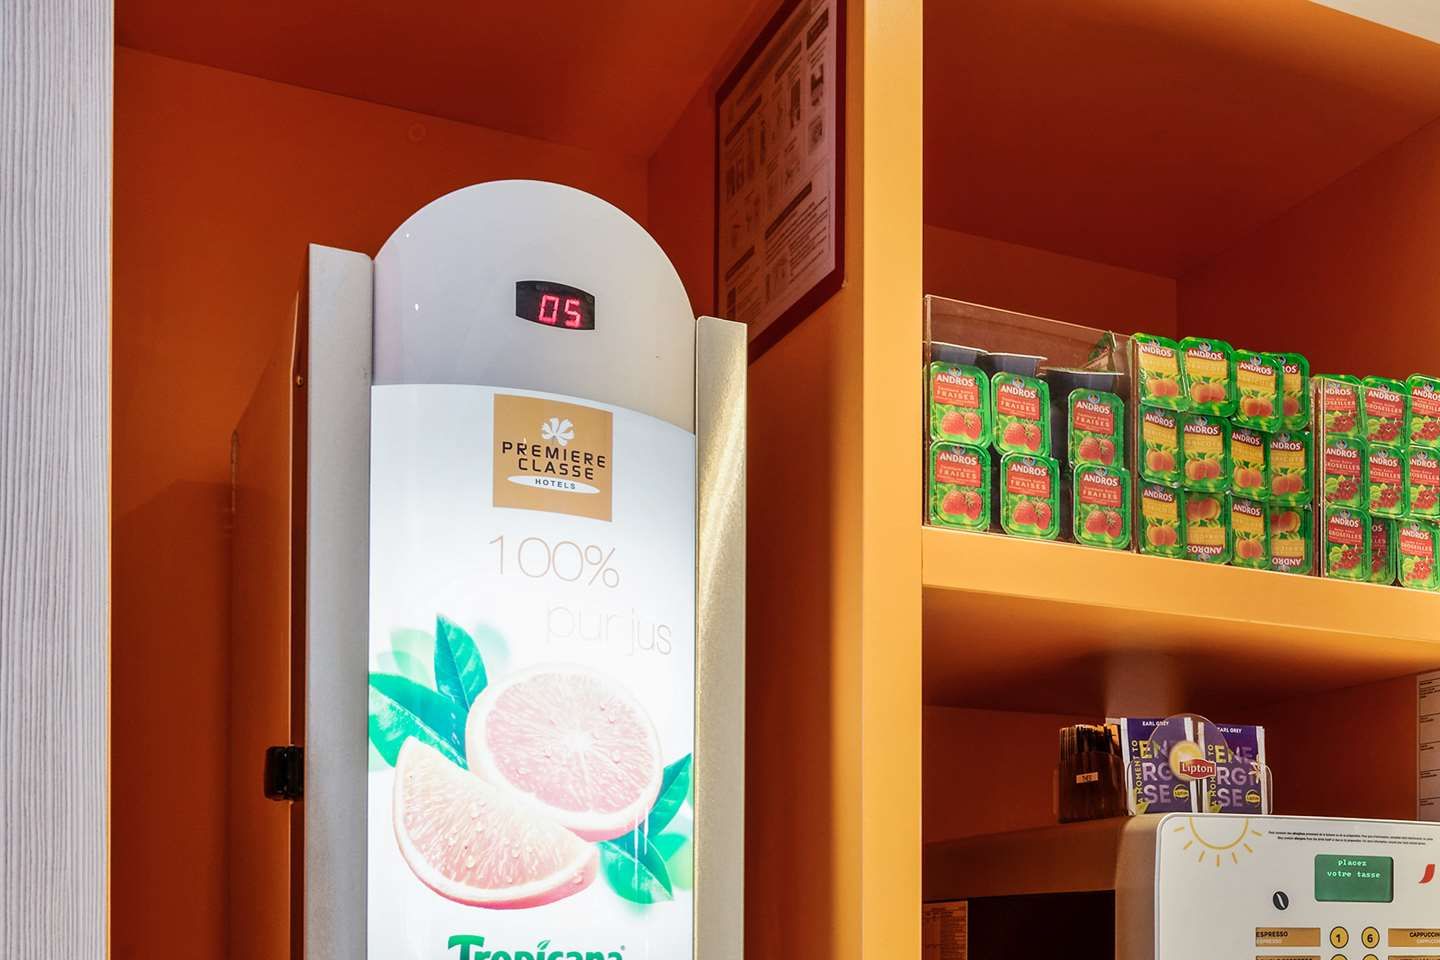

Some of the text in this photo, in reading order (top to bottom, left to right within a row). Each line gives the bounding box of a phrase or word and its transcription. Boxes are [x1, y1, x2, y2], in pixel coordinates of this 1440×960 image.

[538, 295, 582, 328] 05
[1139, 345, 1172, 357] ANDROS
[1188, 350, 1222, 361] ANDROS
[1240, 362, 1272, 375] ANDROS
[936, 374, 974, 386] ANDROS
[936, 390, 975, 401] FRAISES
[1000, 385, 1036, 398] ANDROS
[1368, 391, 1400, 402] ANDROS
[1076, 401, 1110, 414] ANDROS
[1145, 414, 1174, 428] ANDROS
[1184, 425, 1218, 435] ANDROS
[1232, 432, 1260, 445] ANDROS
[502, 441, 606, 468] PREMIERE
[940, 453, 977, 465] ANDROS
[1326, 448, 1357, 458] ANDROS
[1370, 456, 1398, 467] ANDROS
[518, 458, 594, 480] CLASSE
[939, 469, 977, 479] FRAISES
[1011, 464, 1047, 476] ANDROS
[535, 478, 576, 490] HOTELS
[1010, 480, 1046, 490] FRAISES
[1083, 474, 1118, 486] ANDROS
[1143, 489, 1172, 502] ANDROS
[1233, 503, 1261, 516] ANDROS
[1330, 517, 1359, 528] ANDROS
[1402, 530, 1429, 540] ANDROS
[489, 535, 620, 588] 100%
[1271, 557, 1301, 566] ANDRO
[546, 605, 672, 656] pur jus
[1182, 763, 1213, 774] Lipton
[1336, 934, 1340, 943] 1
[1367, 934, 1373, 943] 6
